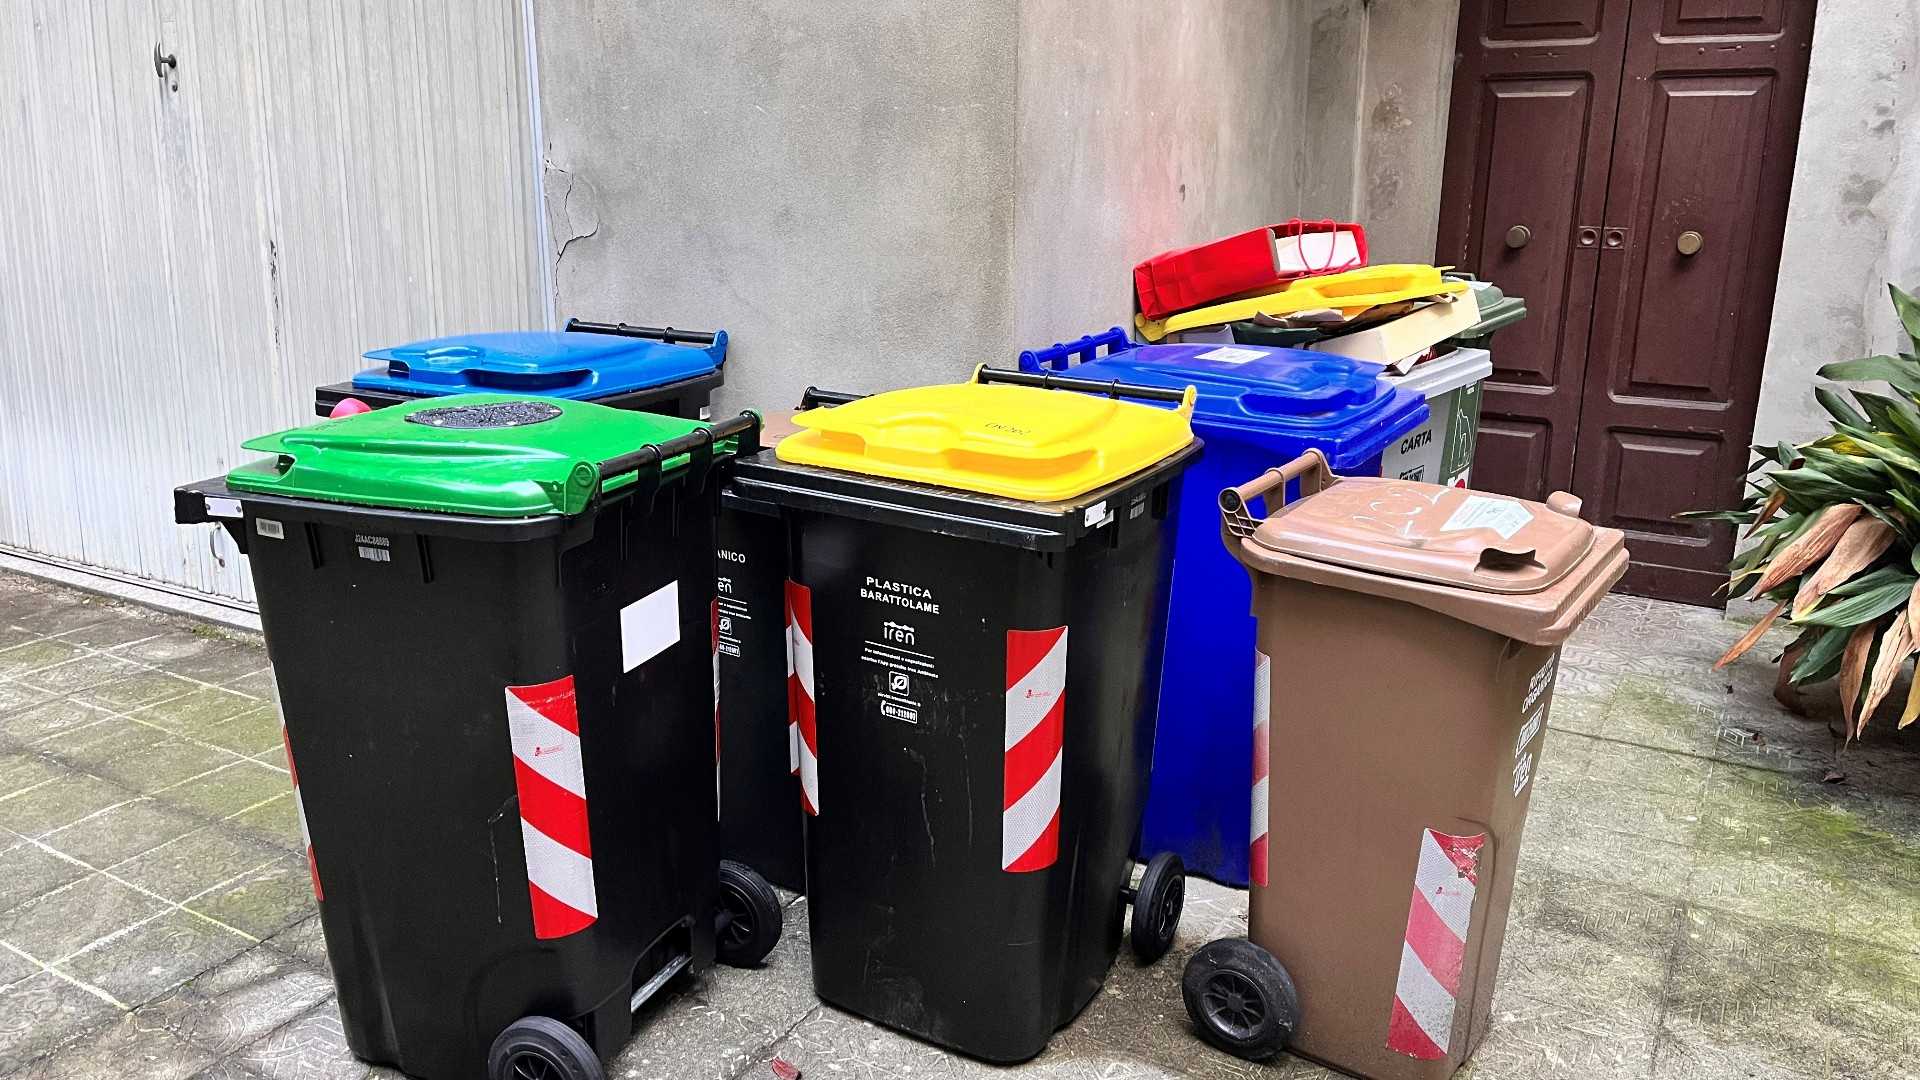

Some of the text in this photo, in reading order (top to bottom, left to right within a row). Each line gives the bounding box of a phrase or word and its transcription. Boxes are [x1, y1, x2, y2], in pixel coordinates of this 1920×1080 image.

[1400, 429, 1432, 455] CARTA
[866, 576, 932, 600] PLASTICA
[860, 588, 940, 614] BARATTOLAME
[883, 624, 915, 646] iren
